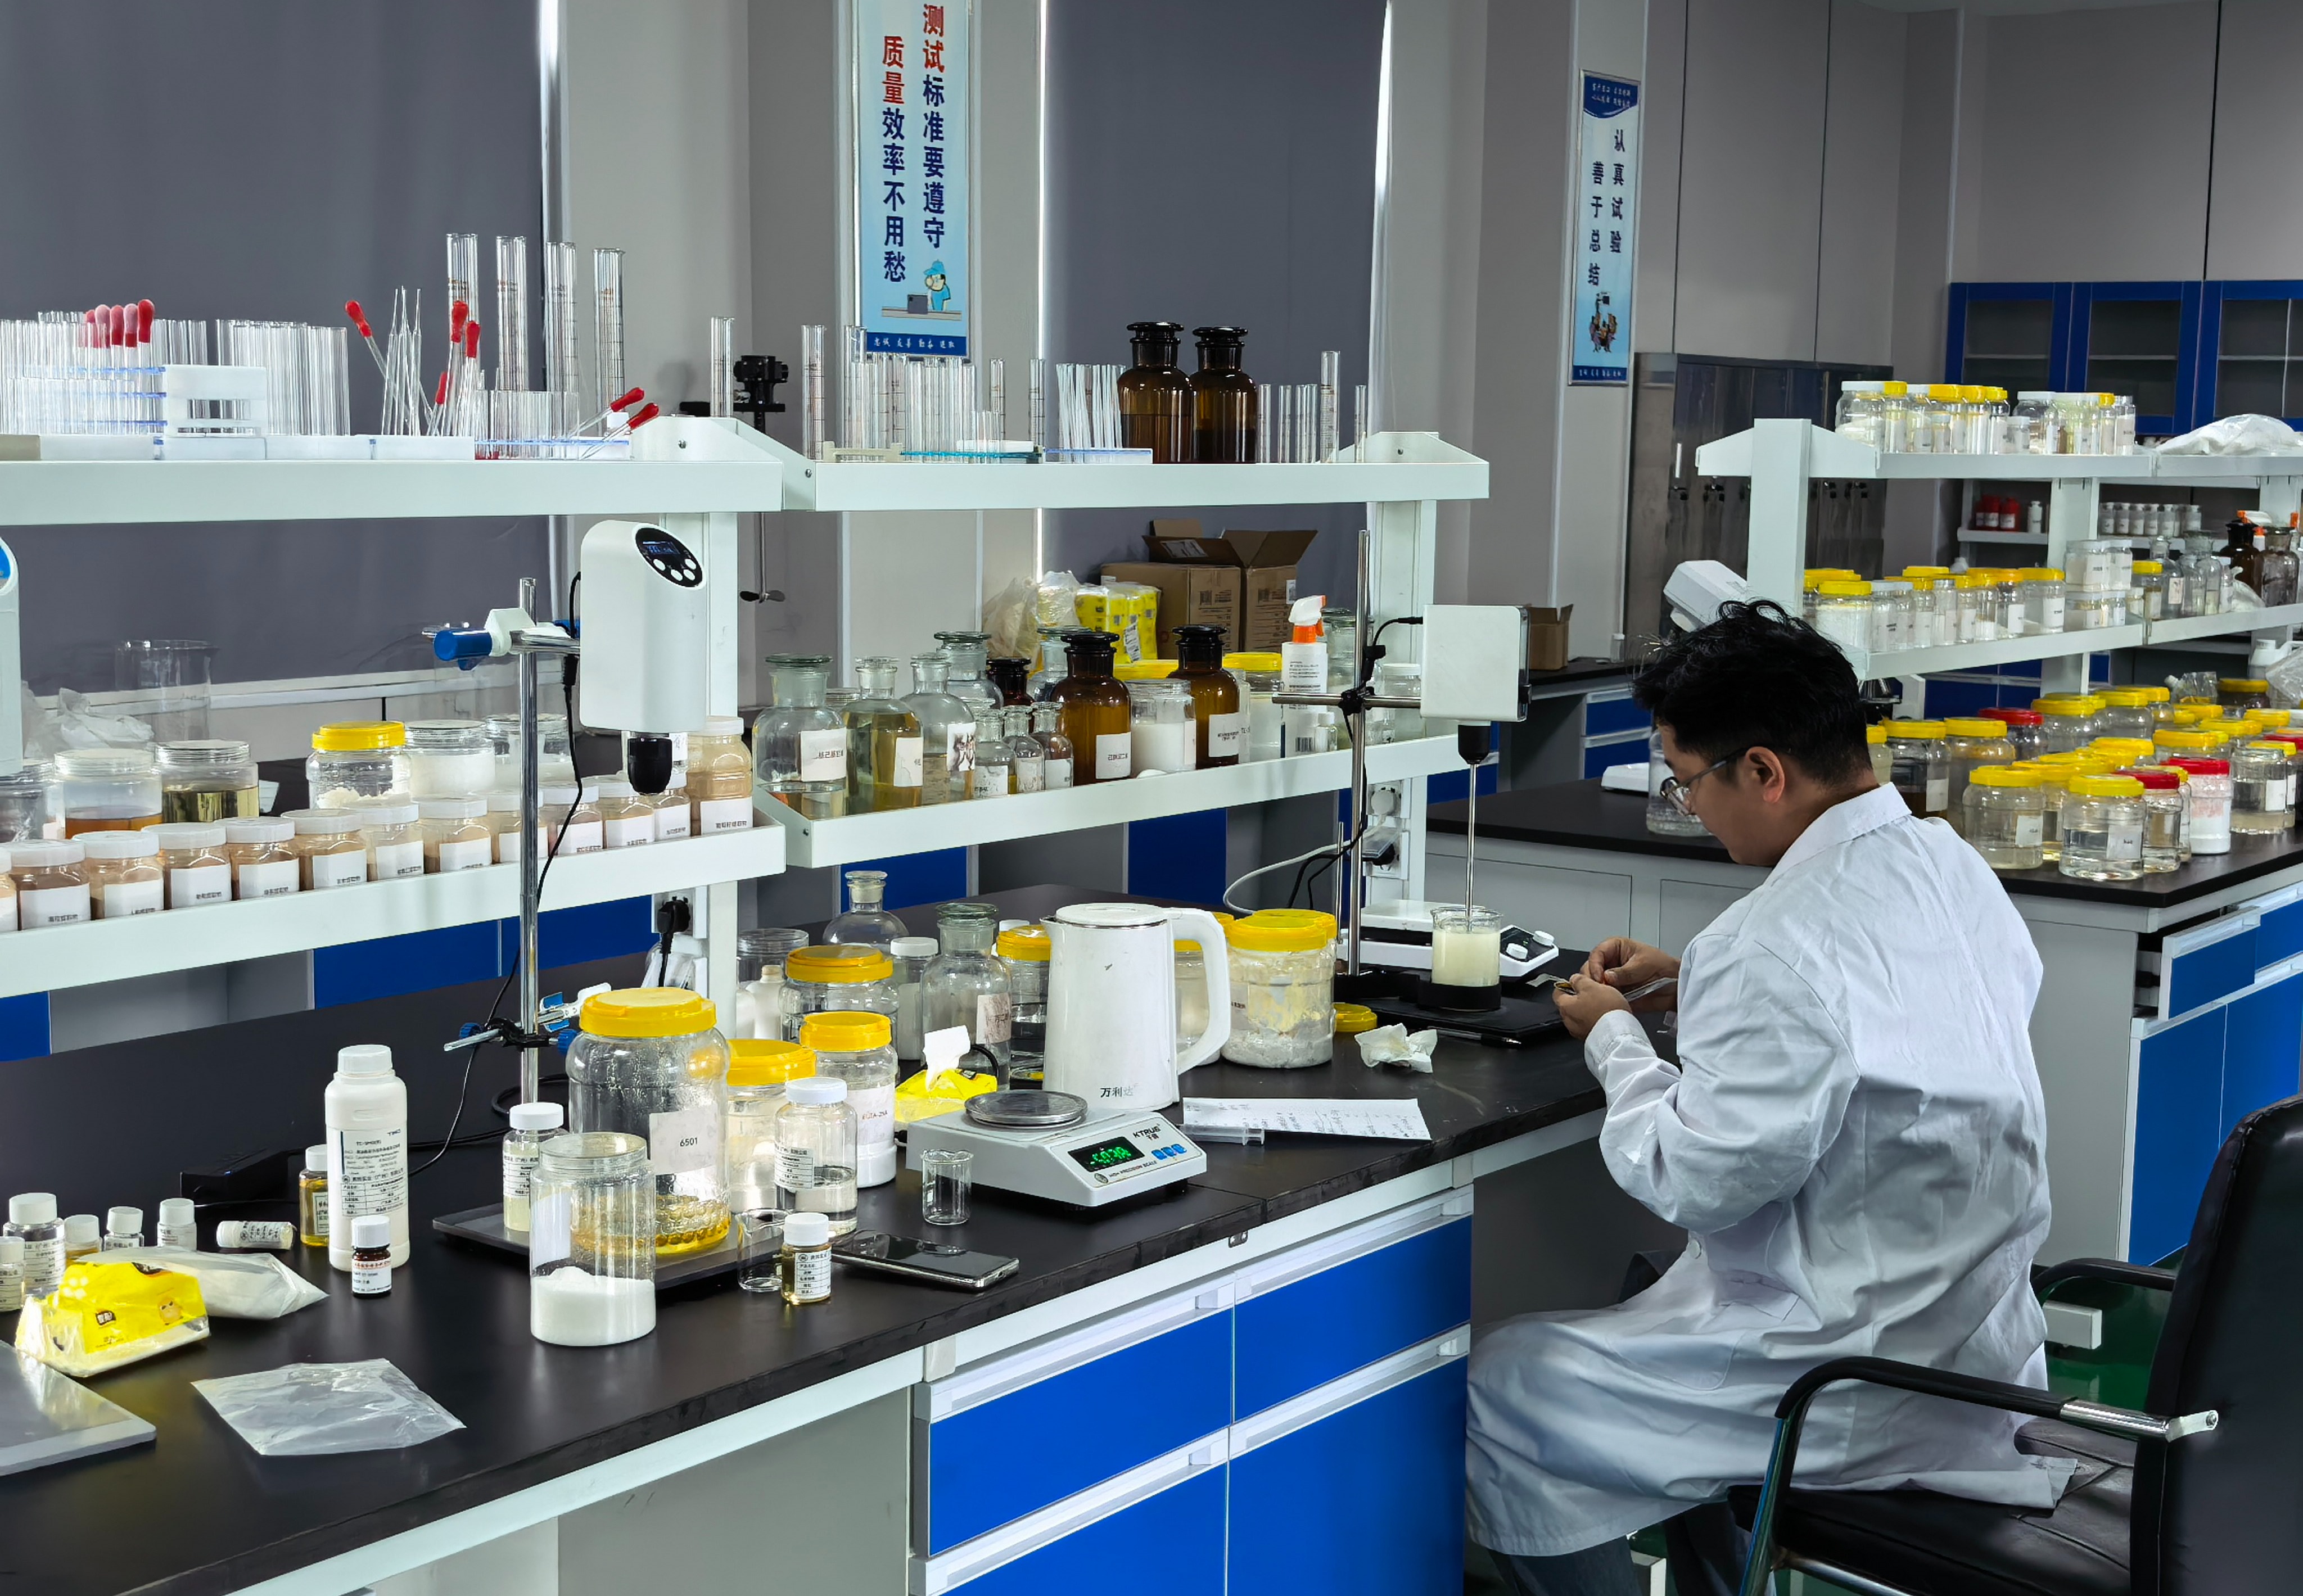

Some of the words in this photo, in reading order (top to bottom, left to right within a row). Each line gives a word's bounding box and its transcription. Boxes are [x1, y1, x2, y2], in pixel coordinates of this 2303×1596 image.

[923, 4, 945, 249] 测试标准要遵守
[882, 35, 906, 283] 质量效率不用愁
[1100, 1086, 1134, 1098] 万利达
[1132, 1125, 1161, 1138] KTRUE
[680, 1137, 698, 1147] 6501
